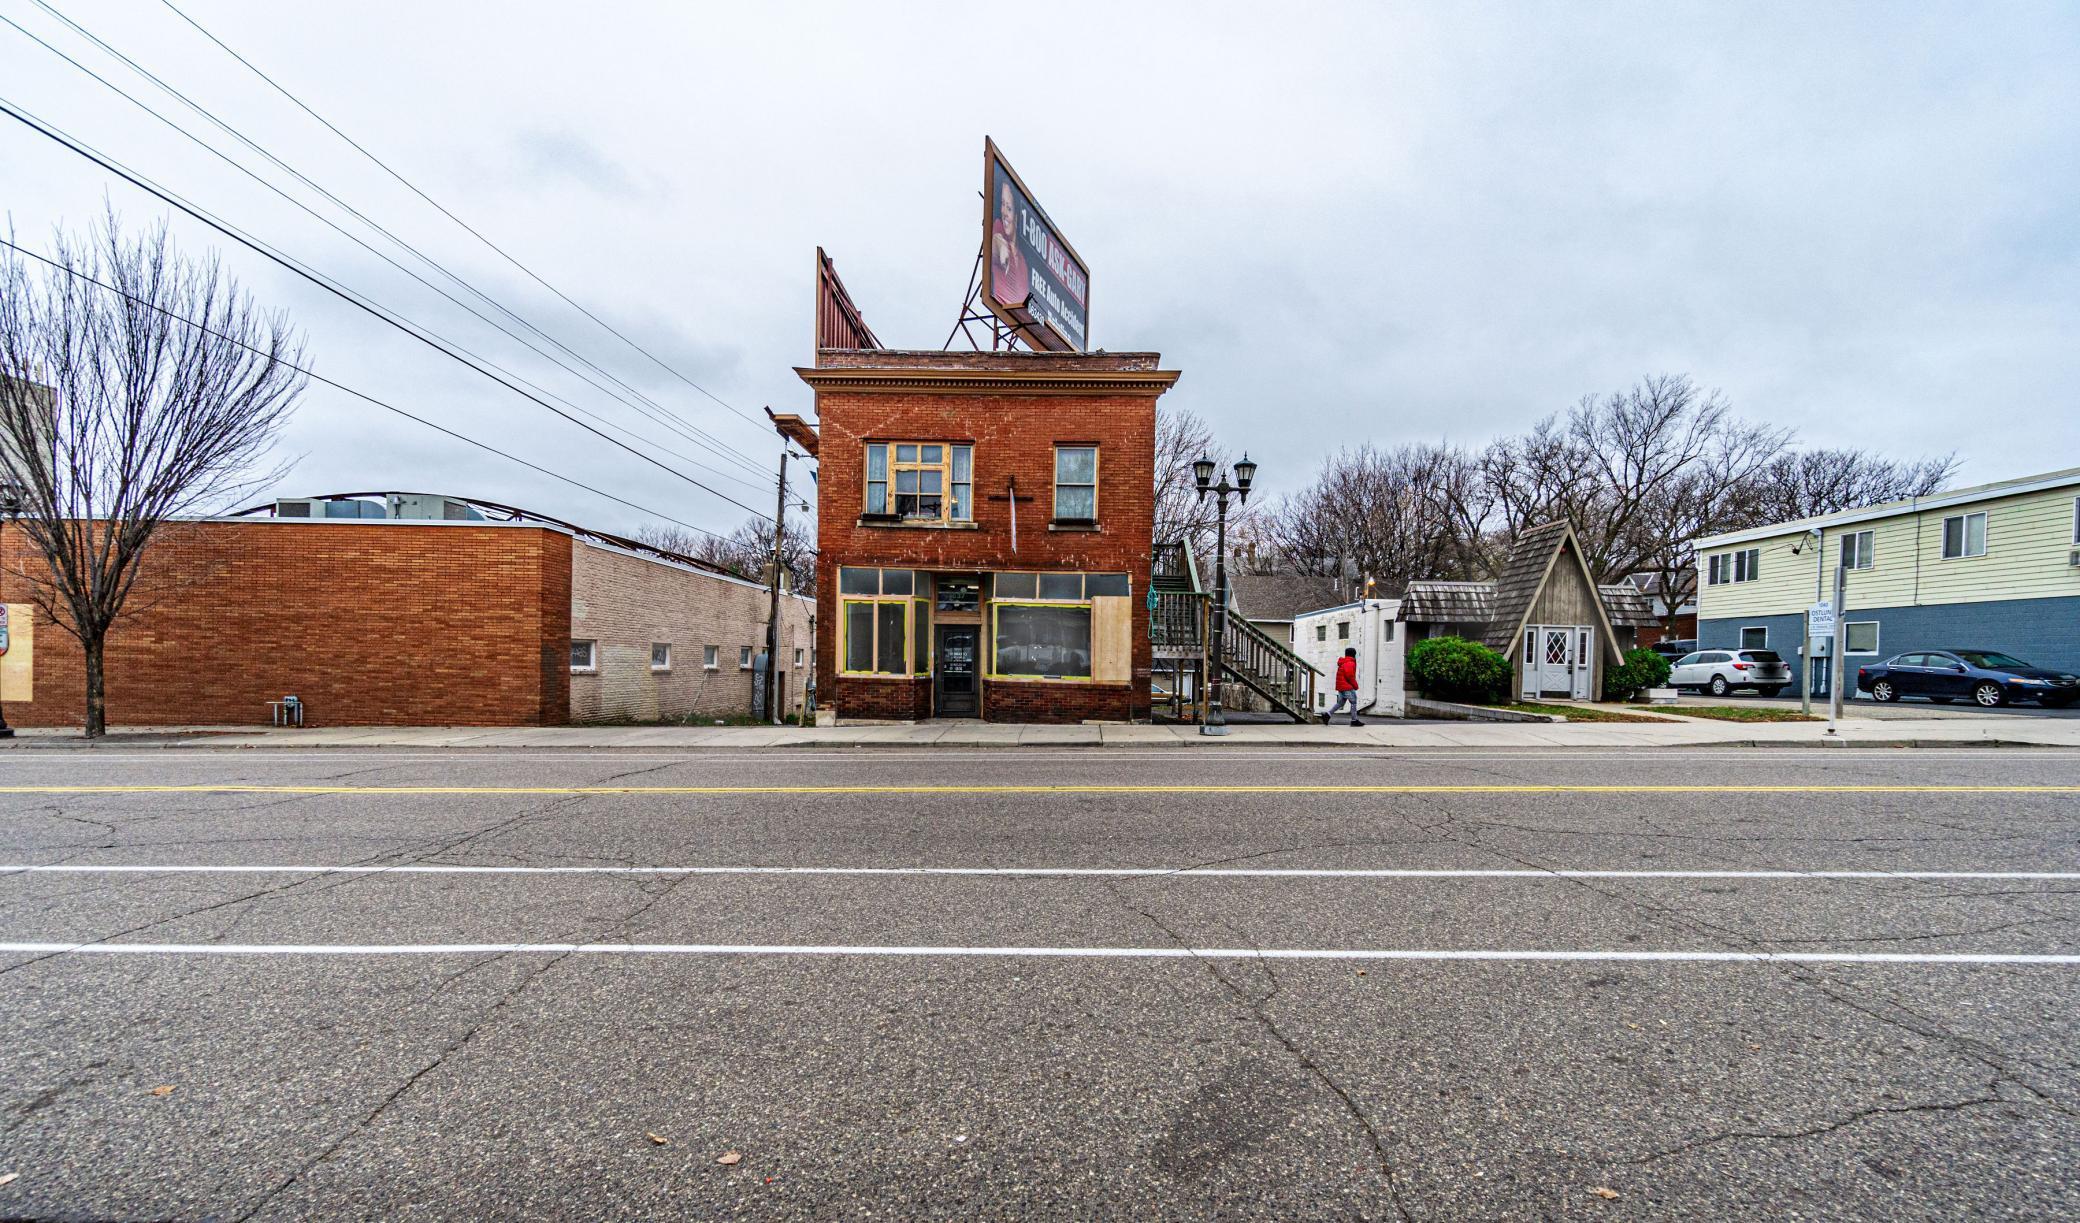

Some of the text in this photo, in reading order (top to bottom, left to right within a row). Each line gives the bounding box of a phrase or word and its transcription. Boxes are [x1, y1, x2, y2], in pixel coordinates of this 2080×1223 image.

[1021, 208, 1047, 260] 1-800
[1048, 241, 1086, 305] ASK-GARY
[1031, 267, 1047, 298] FREE
[1046, 284, 1061, 313] Auto
